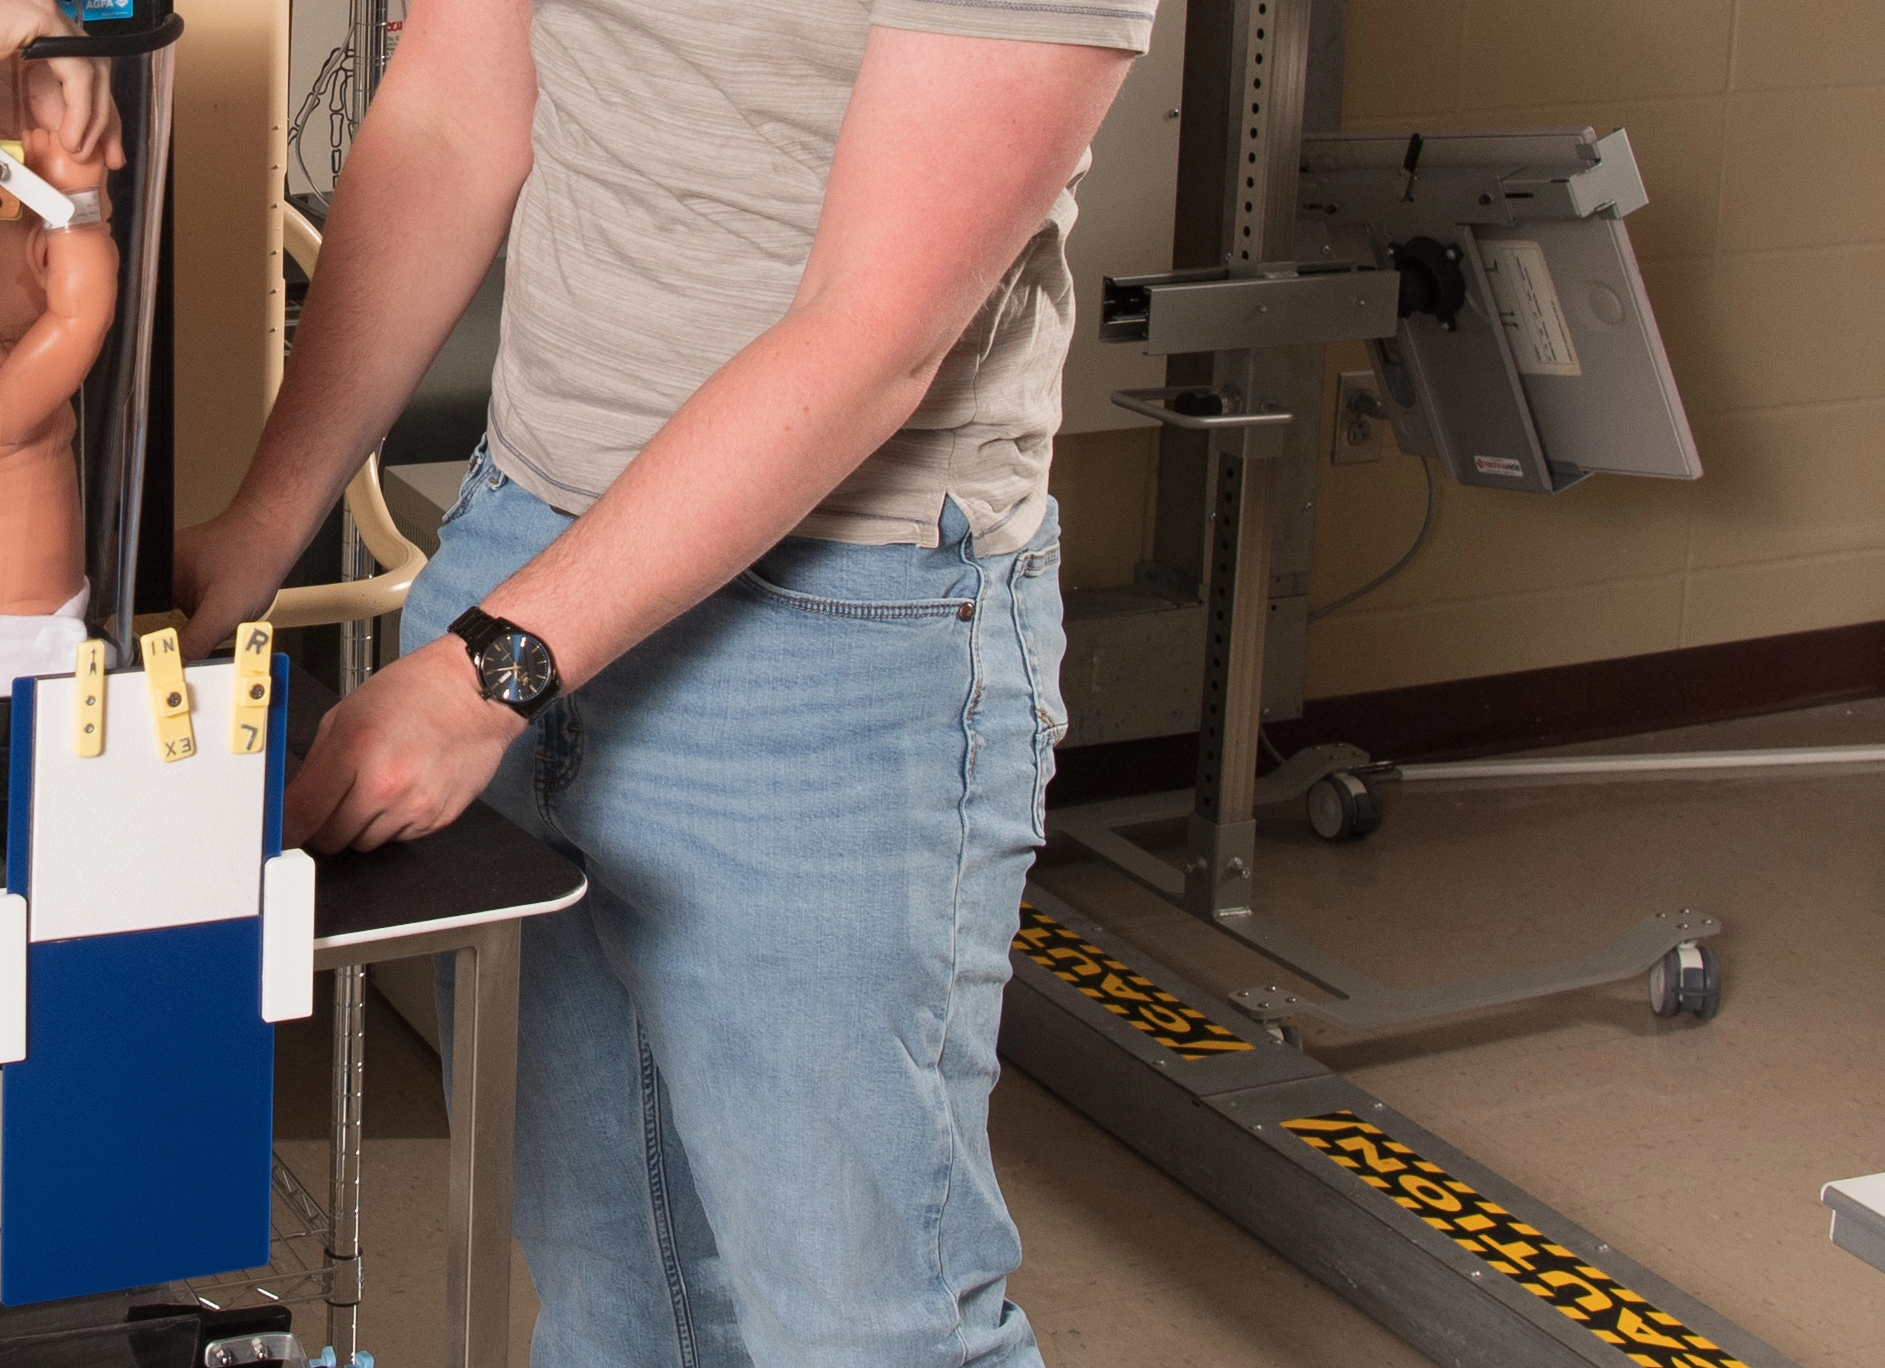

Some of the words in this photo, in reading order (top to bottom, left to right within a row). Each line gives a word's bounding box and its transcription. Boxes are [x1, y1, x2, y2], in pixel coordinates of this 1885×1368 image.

[150, 637, 175, 656] IN
[245, 628, 269, 655] R
[1017, 926, 1193, 1034] CAUT
[1334, 1134, 1720, 1368] AUTION
